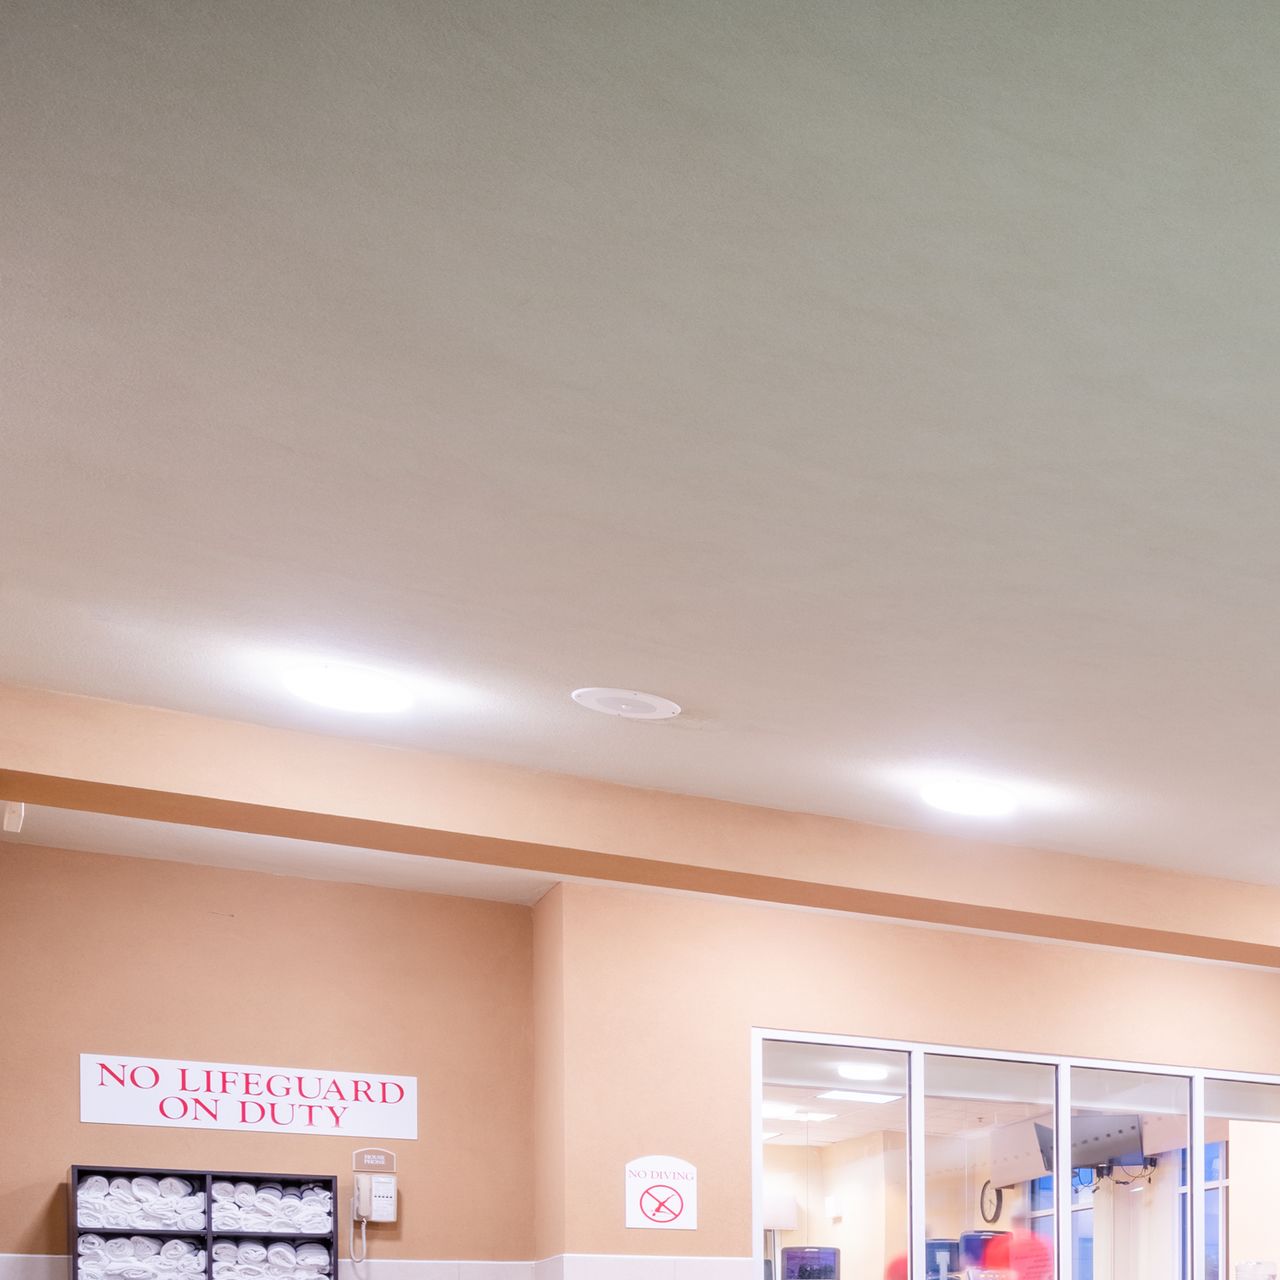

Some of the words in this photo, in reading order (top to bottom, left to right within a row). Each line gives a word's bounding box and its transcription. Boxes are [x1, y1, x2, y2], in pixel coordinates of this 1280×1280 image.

[96, 1063, 160, 1090] NO
[178, 1068, 405, 1105] LIFEGUARD
[158, 1096, 219, 1123] ON
[239, 1100, 349, 1128] DUTY
